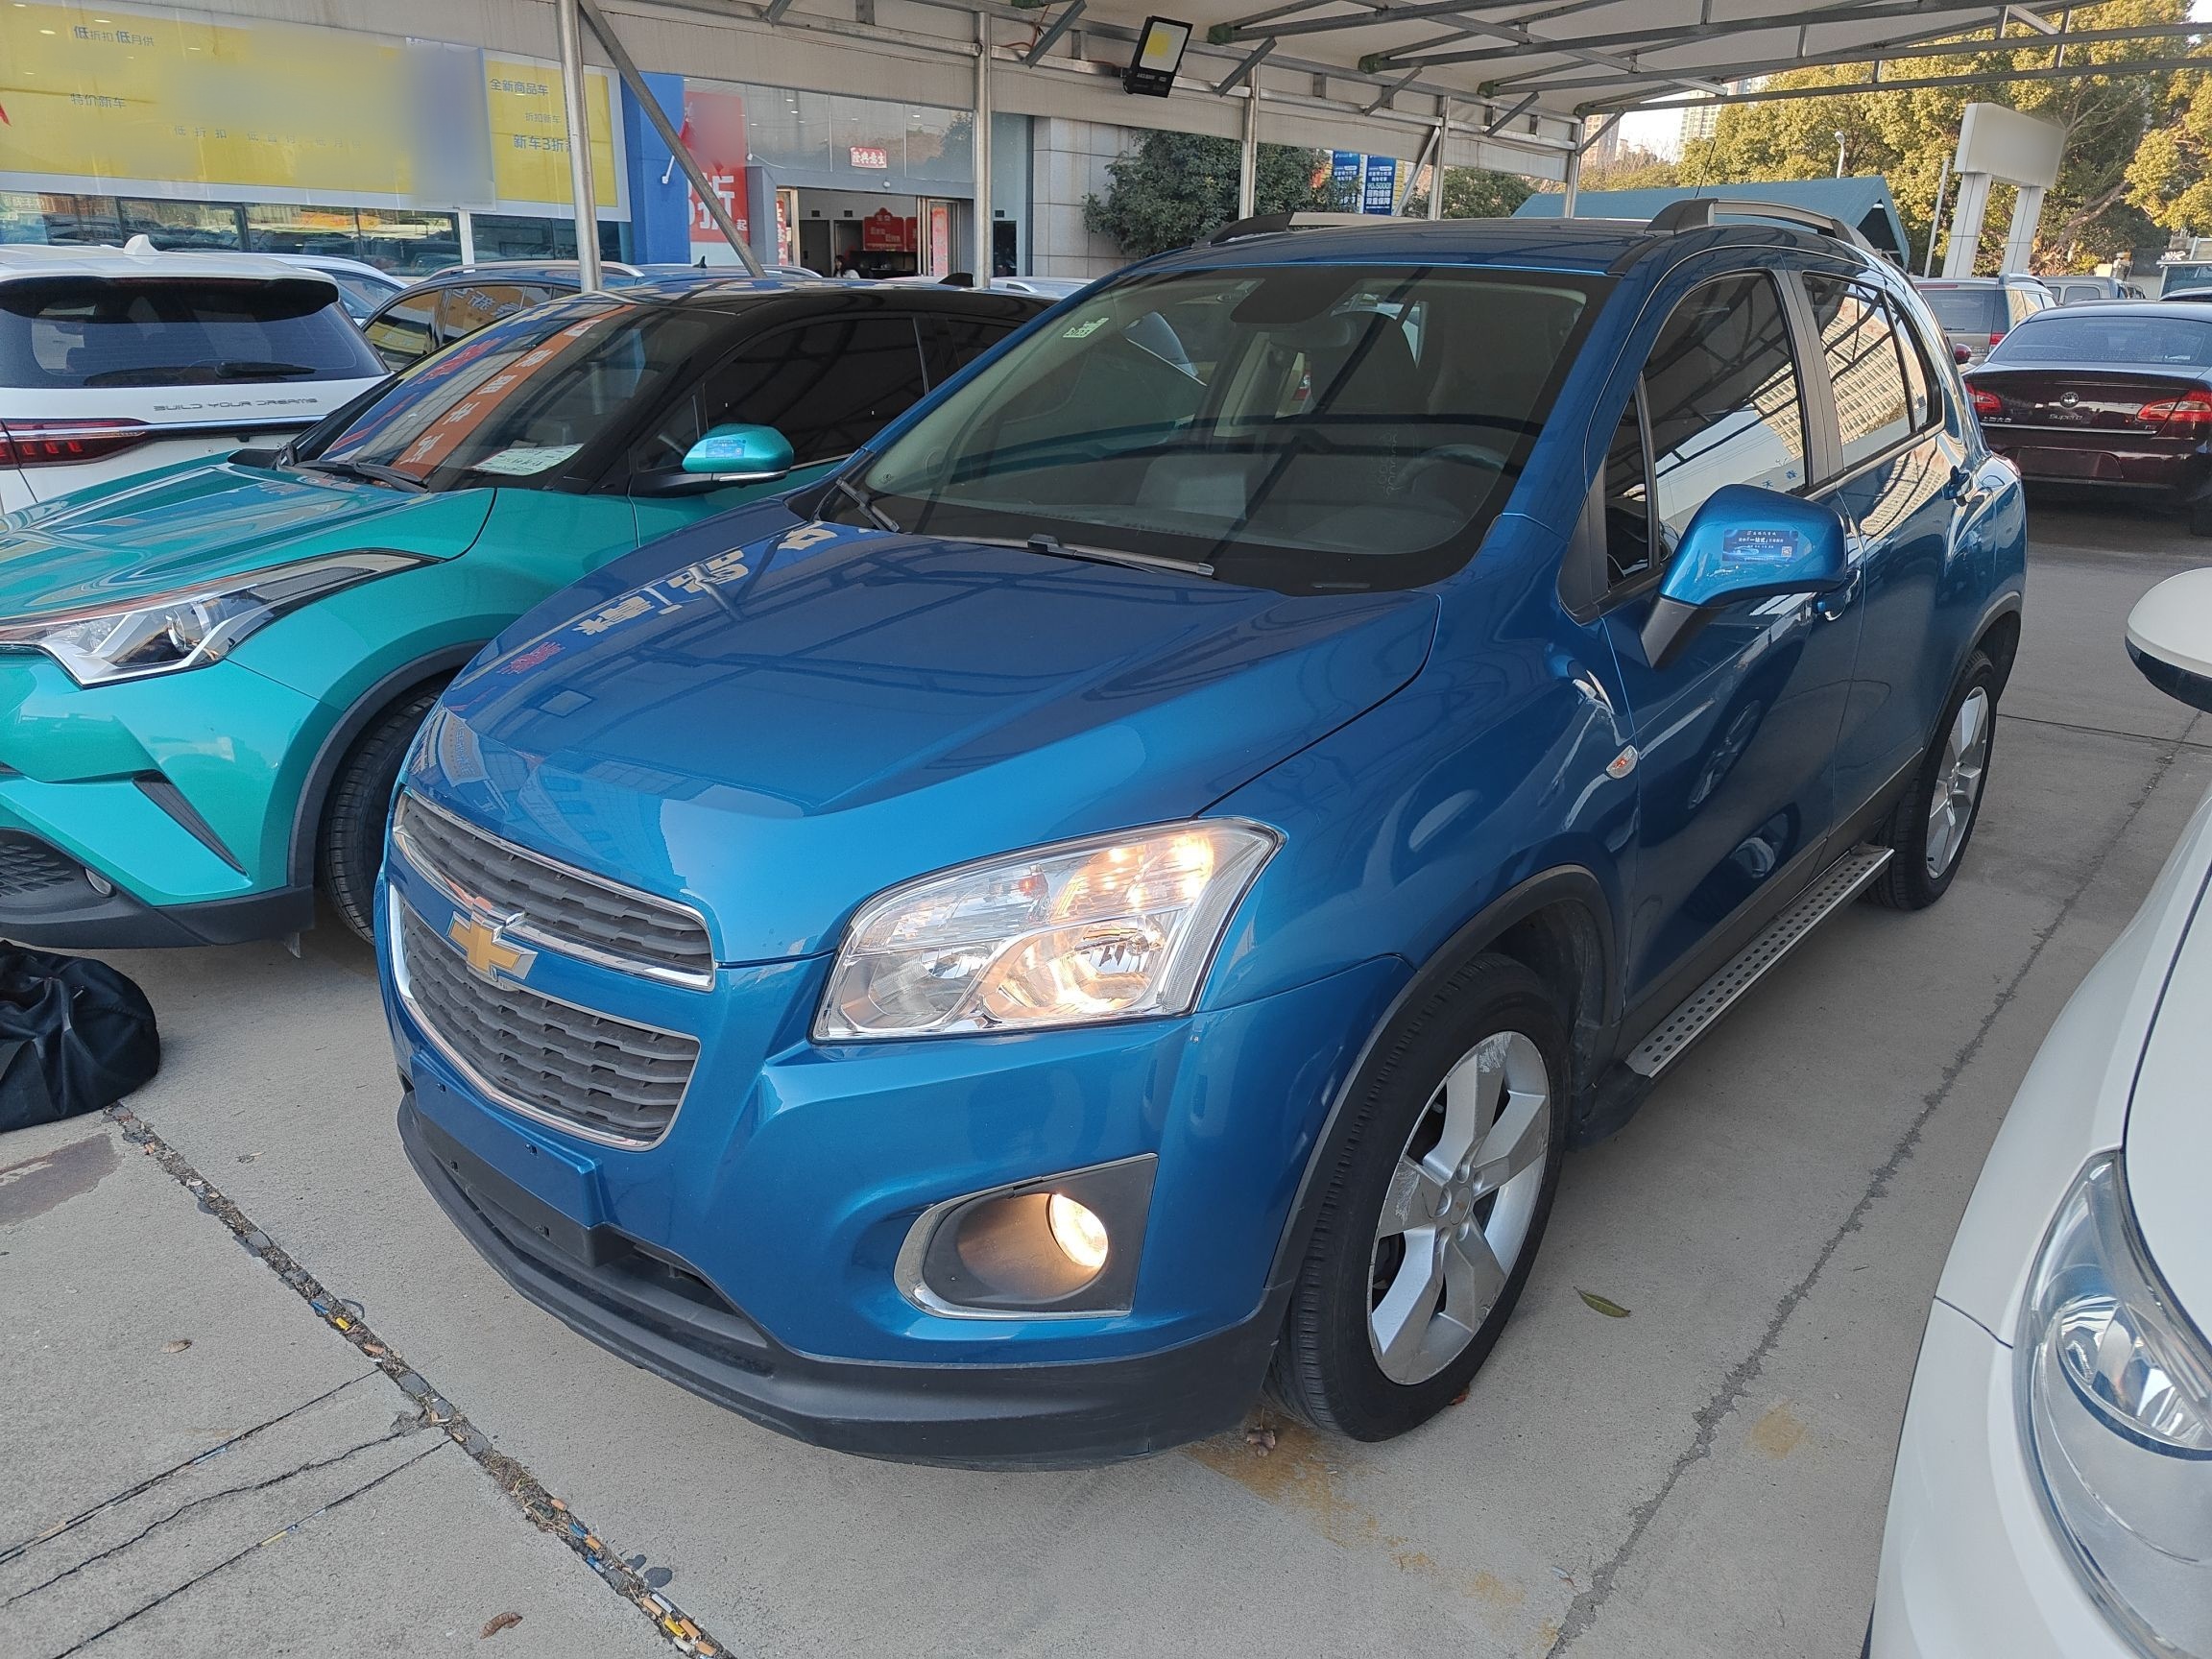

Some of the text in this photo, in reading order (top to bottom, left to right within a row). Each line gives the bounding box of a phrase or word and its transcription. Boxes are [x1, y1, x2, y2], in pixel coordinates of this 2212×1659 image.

[490, 78, 549, 96] 全新商品车
[70, 92, 126, 108] 特价新车
[254, 397, 318, 406] DREAMS
